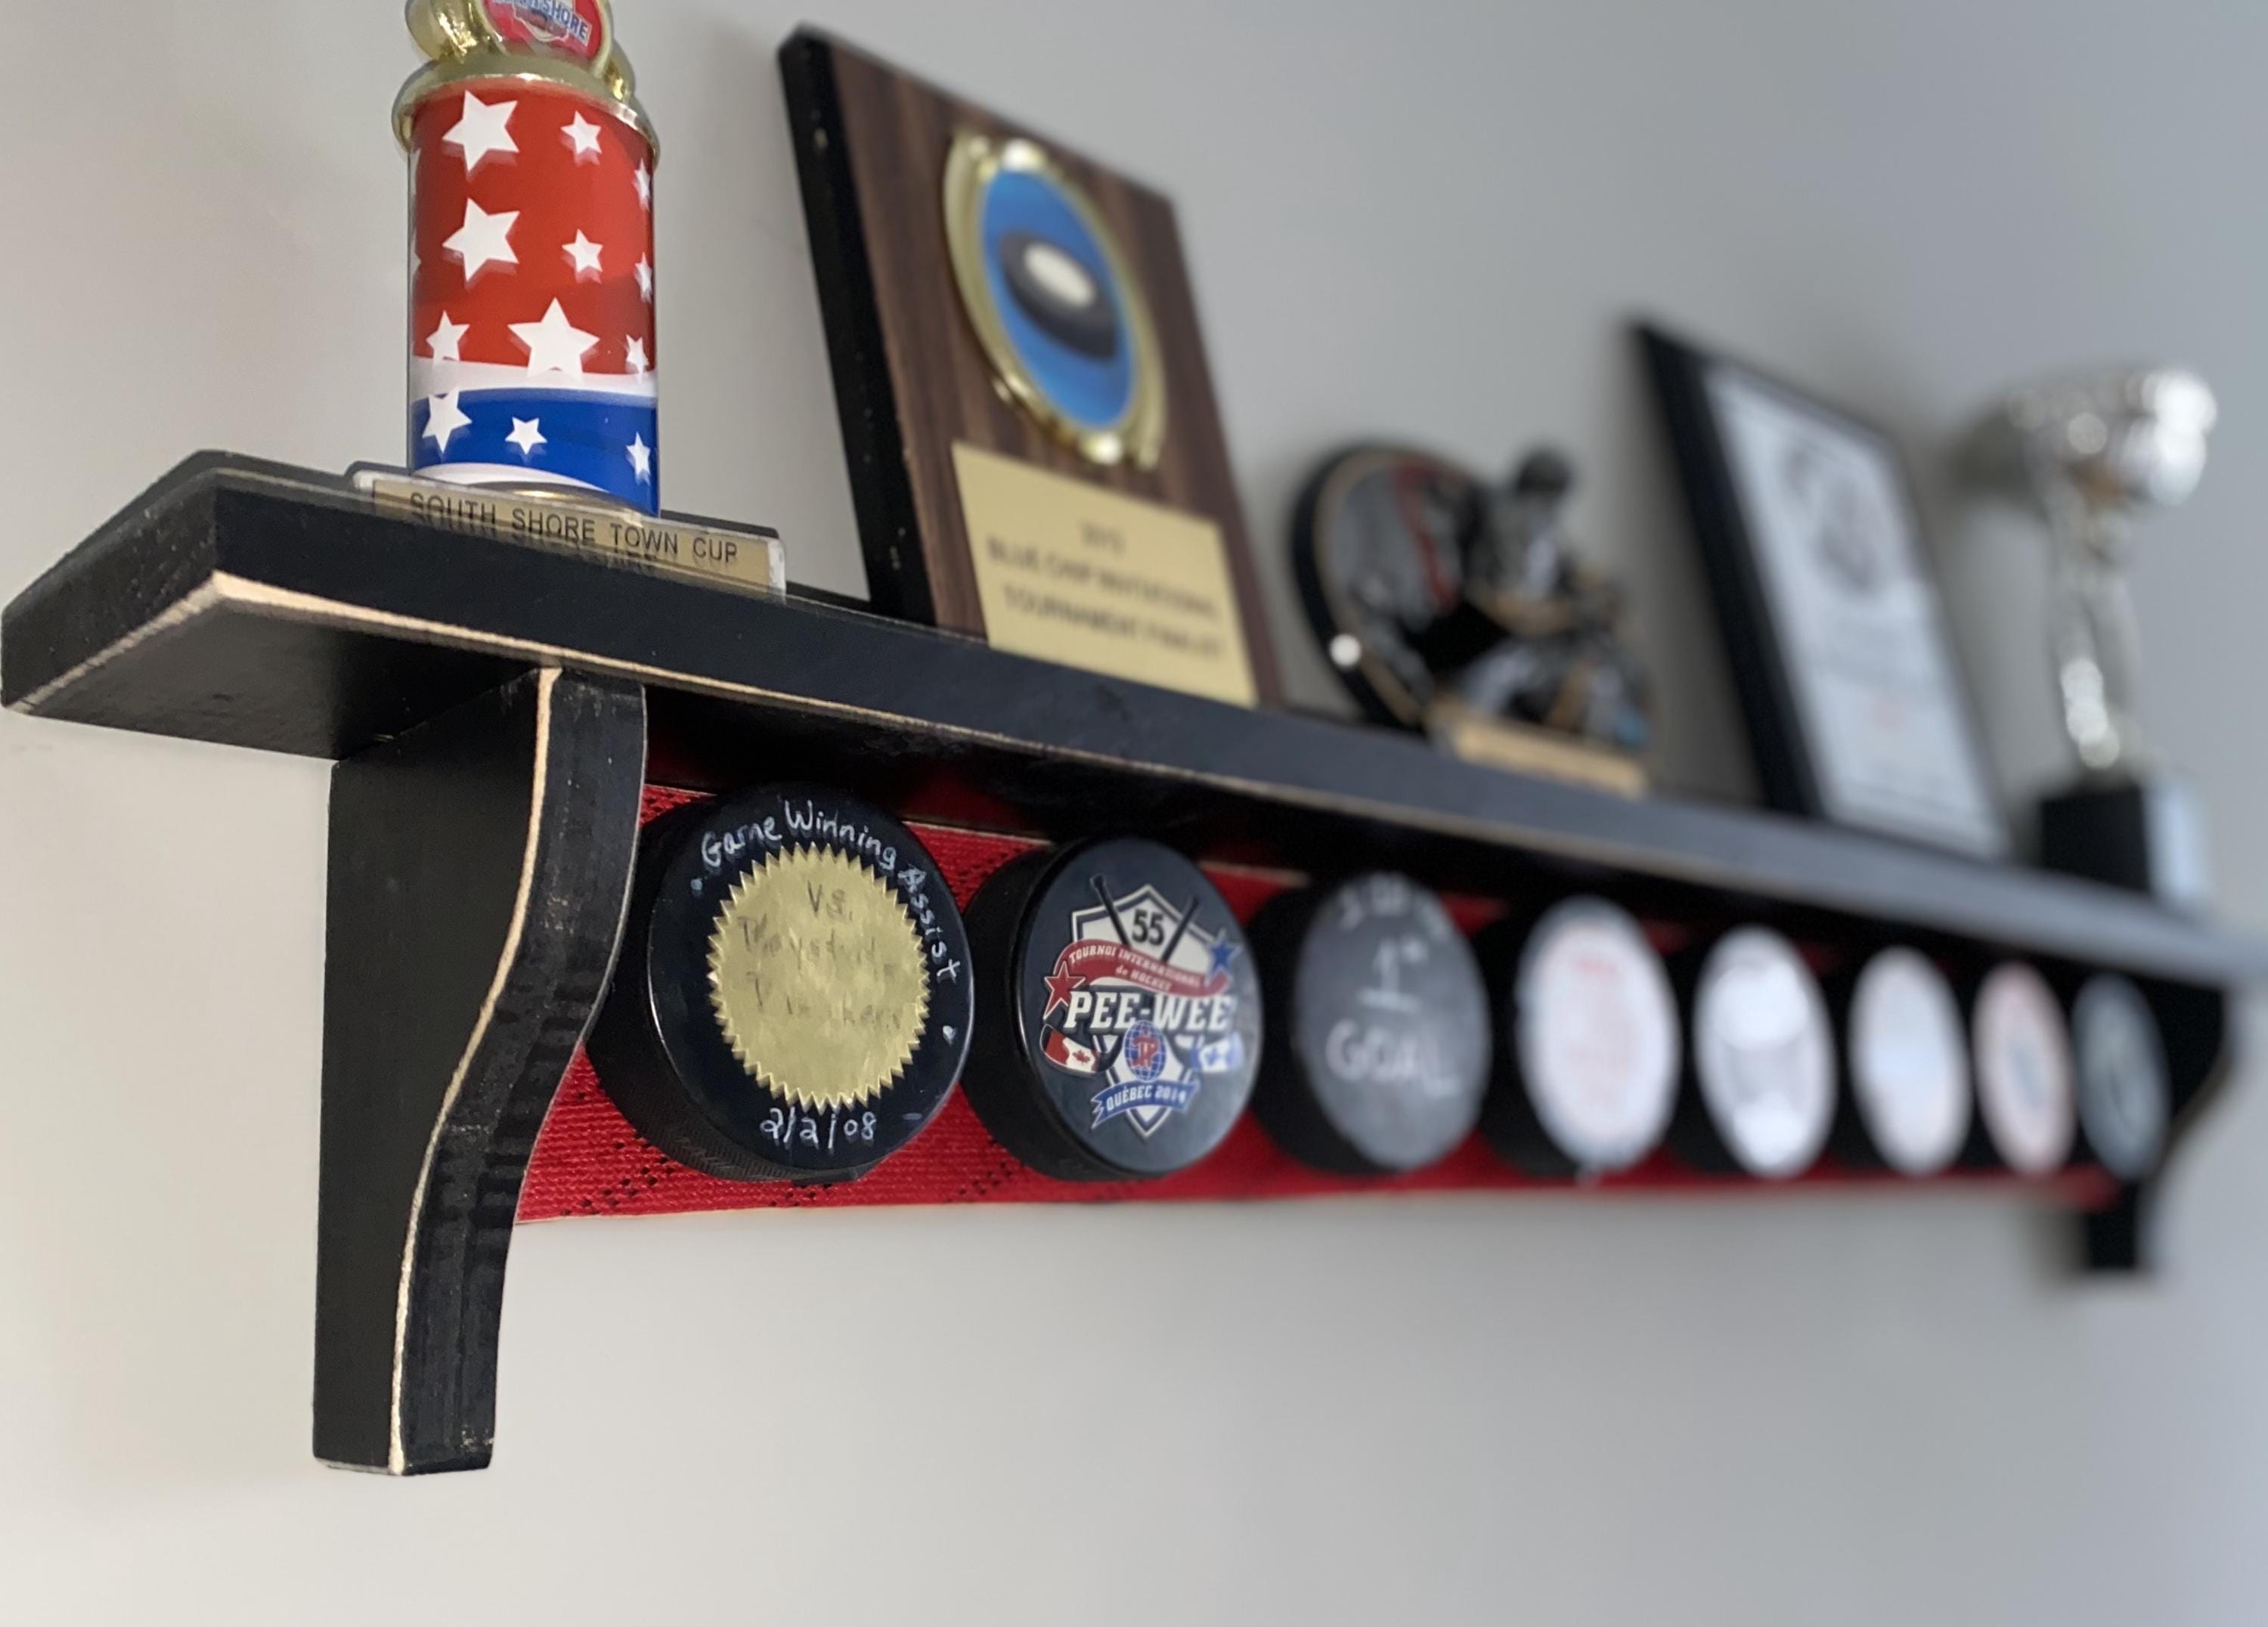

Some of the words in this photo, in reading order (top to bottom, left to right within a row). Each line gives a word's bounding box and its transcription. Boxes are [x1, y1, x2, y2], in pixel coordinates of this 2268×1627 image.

[410, 491, 497, 525] SOUTH
[511, 507, 596, 544] SHORE
[610, 522, 678, 556] TOWN
[692, 536, 738, 563] CUP
[701, 816, 783, 867] Game
[783, 799, 897, 871] Winning
[897, 866, 961, 979] Assist
[1132, 909, 1165, 946] 55
[1069, 945, 1116, 965] TOURNOI
[1118, 948, 1202, 987] INTERNATIONAL
[1063, 991, 1235, 1031] PEE-WEE
[1325, 1018, 1465, 1099] GOAL
[1106, 1085, 1154, 1112] QUÉBEC
[759, 1106, 877, 1149] 2/2/08
